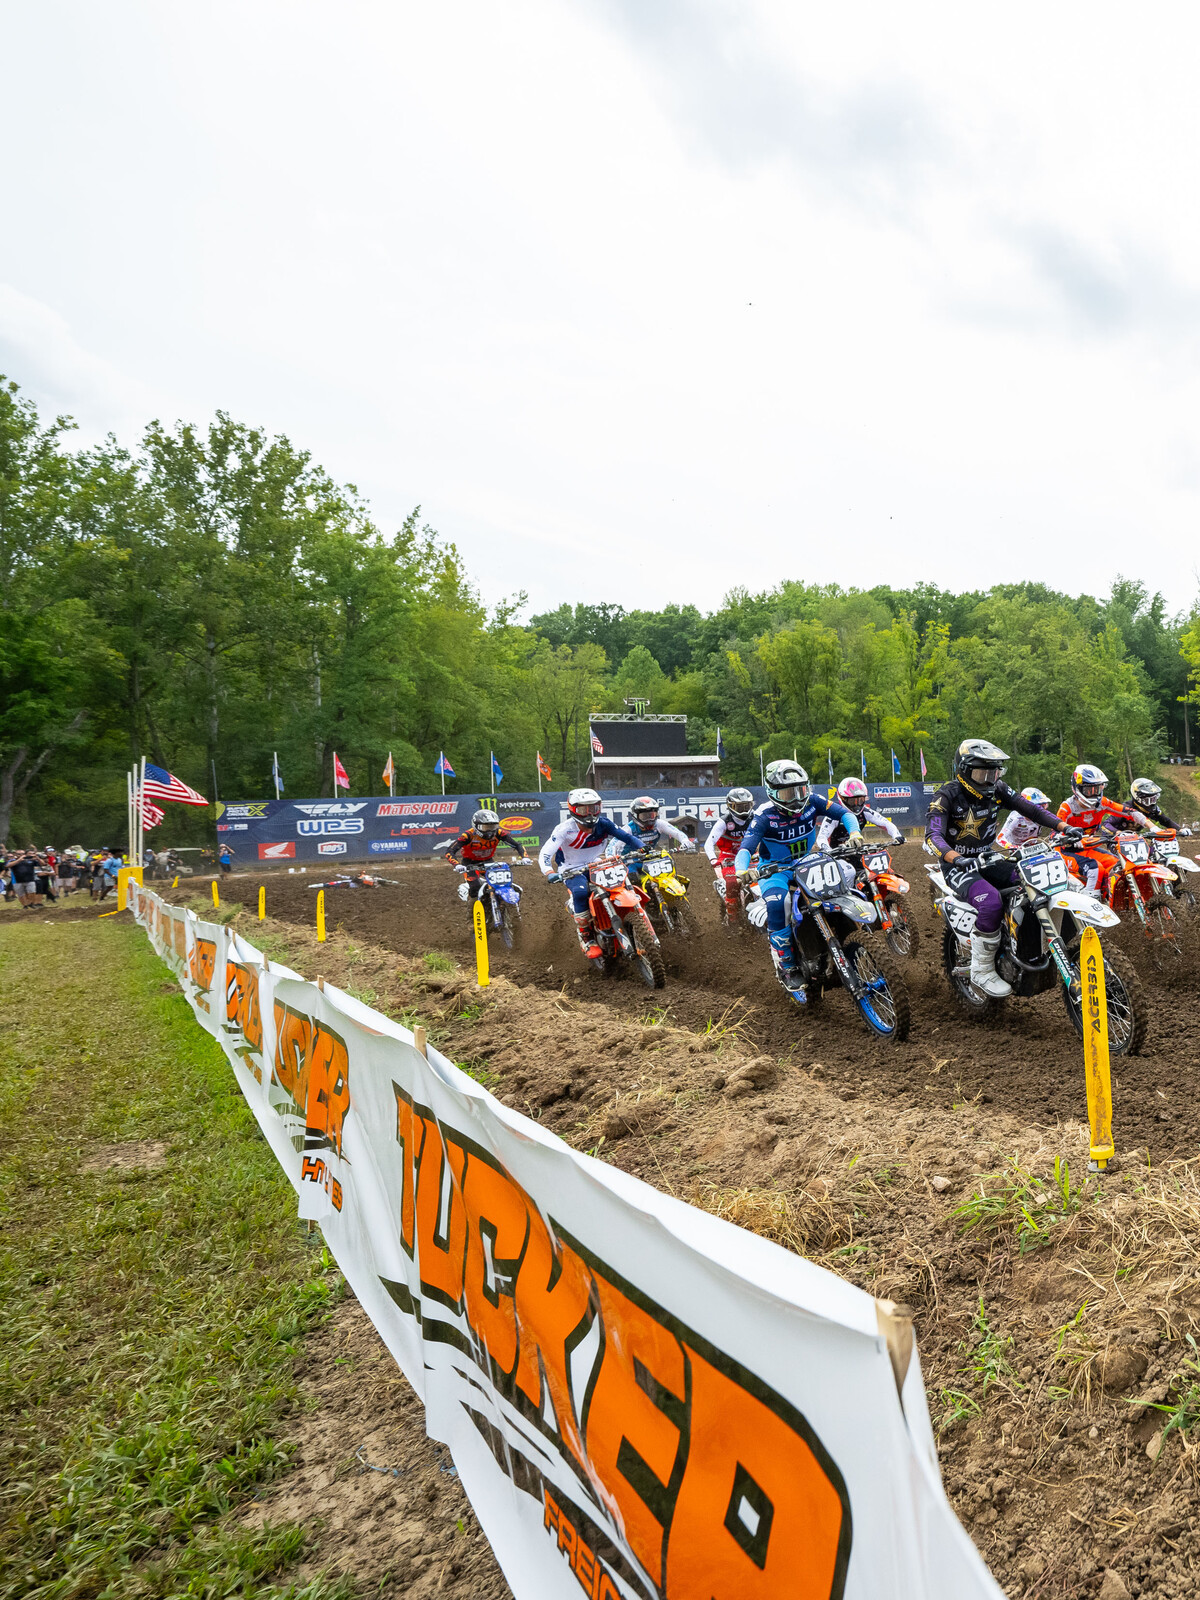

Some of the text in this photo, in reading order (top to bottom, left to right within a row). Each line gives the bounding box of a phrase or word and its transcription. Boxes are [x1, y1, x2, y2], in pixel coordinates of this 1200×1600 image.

[874, 786, 911, 794] PARTS
[293, 803, 369, 815] FLY
[499, 801, 541, 809] MONSTER
[882, 806, 910, 814] DUNLOP
[296, 818, 364, 836] WPS
[401, 821, 443, 830] MX-ATV
[380, 841, 408, 850] YAMAHA
[1123, 842, 1149, 864] 34
[646, 859, 673, 878] 85
[868, 855, 889, 871] 41
[594, 863, 627, 888] 435
[805, 861, 842, 893] 40
[1030, 860, 1067, 892] 38
[949, 906, 978, 934] 38
[830, 946, 850, 979] DUNLOP
[1053, 942, 1077, 978] DUNLOP
[1086, 954, 1102, 1034] ACERBIS
